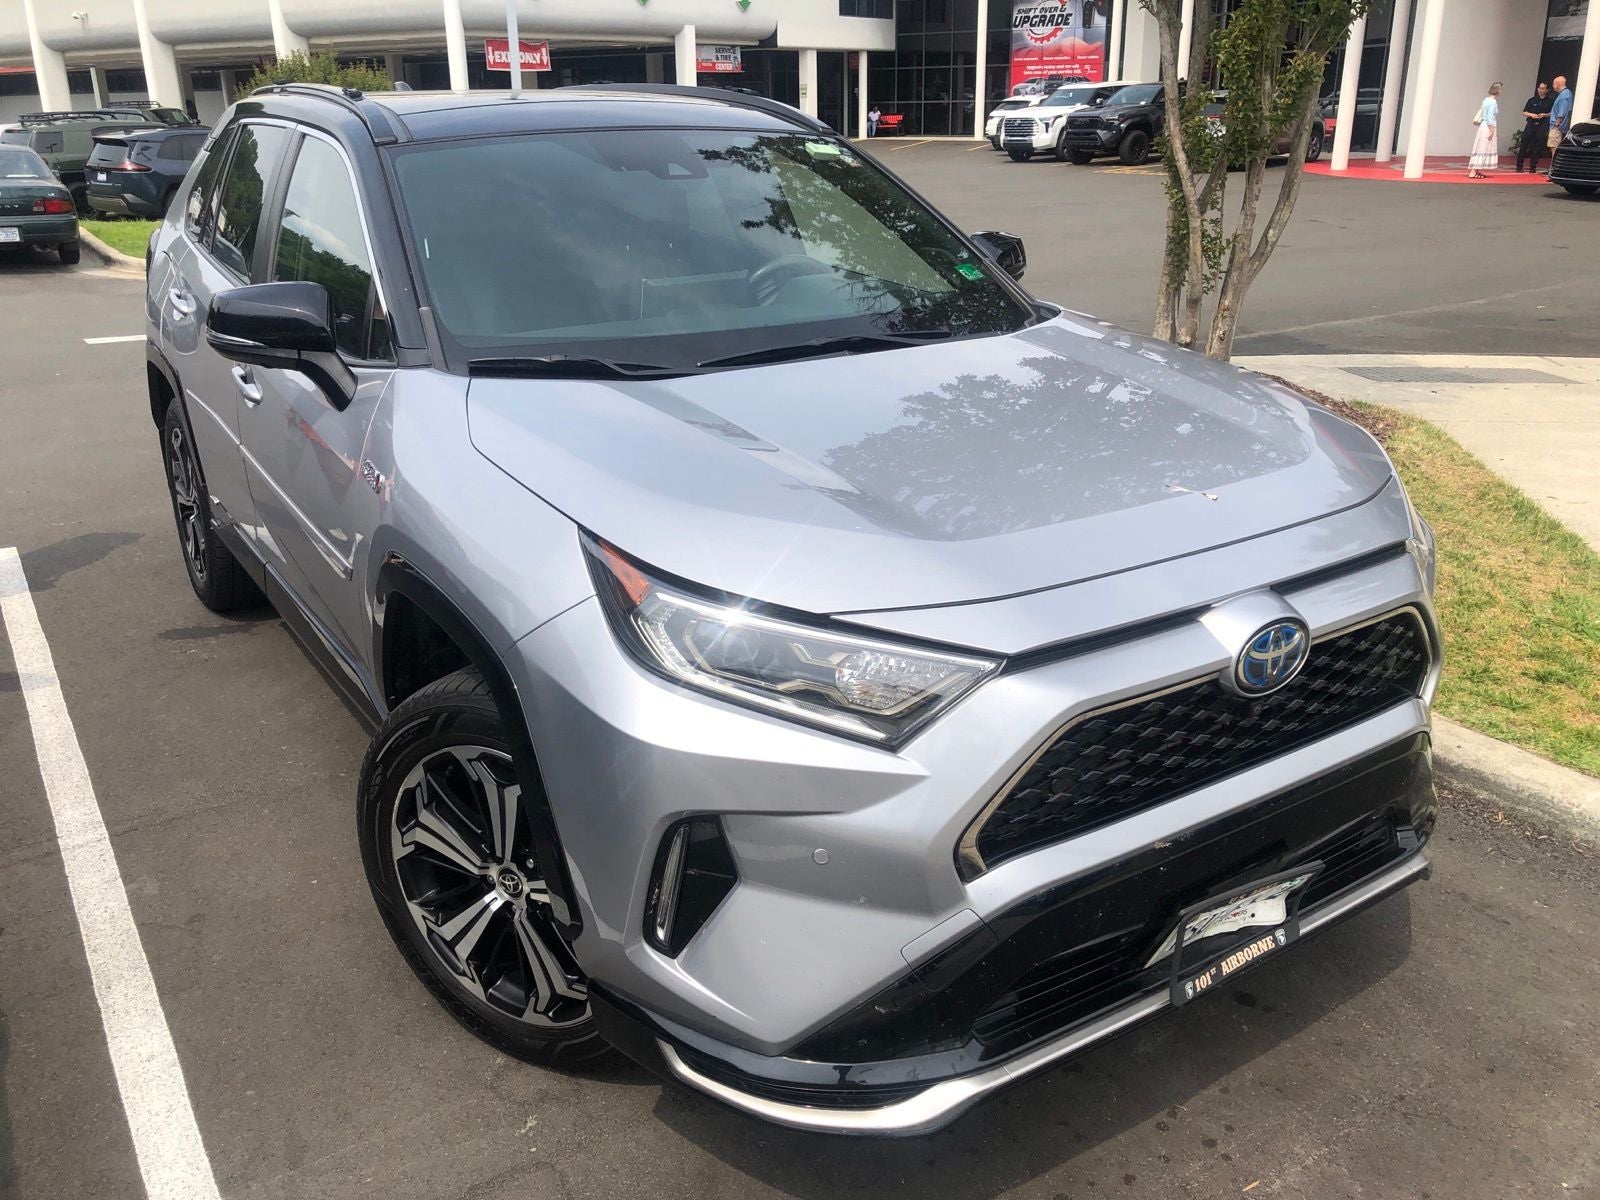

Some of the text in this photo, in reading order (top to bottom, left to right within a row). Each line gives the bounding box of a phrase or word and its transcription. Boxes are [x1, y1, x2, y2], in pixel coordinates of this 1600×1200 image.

[1059, 4, 1067, 12] &
[1013, 13, 1073, 28] UPGRADE
[494, 51, 511, 63] EXI
[1220, 935, 1276, 977] AIRBORNE
